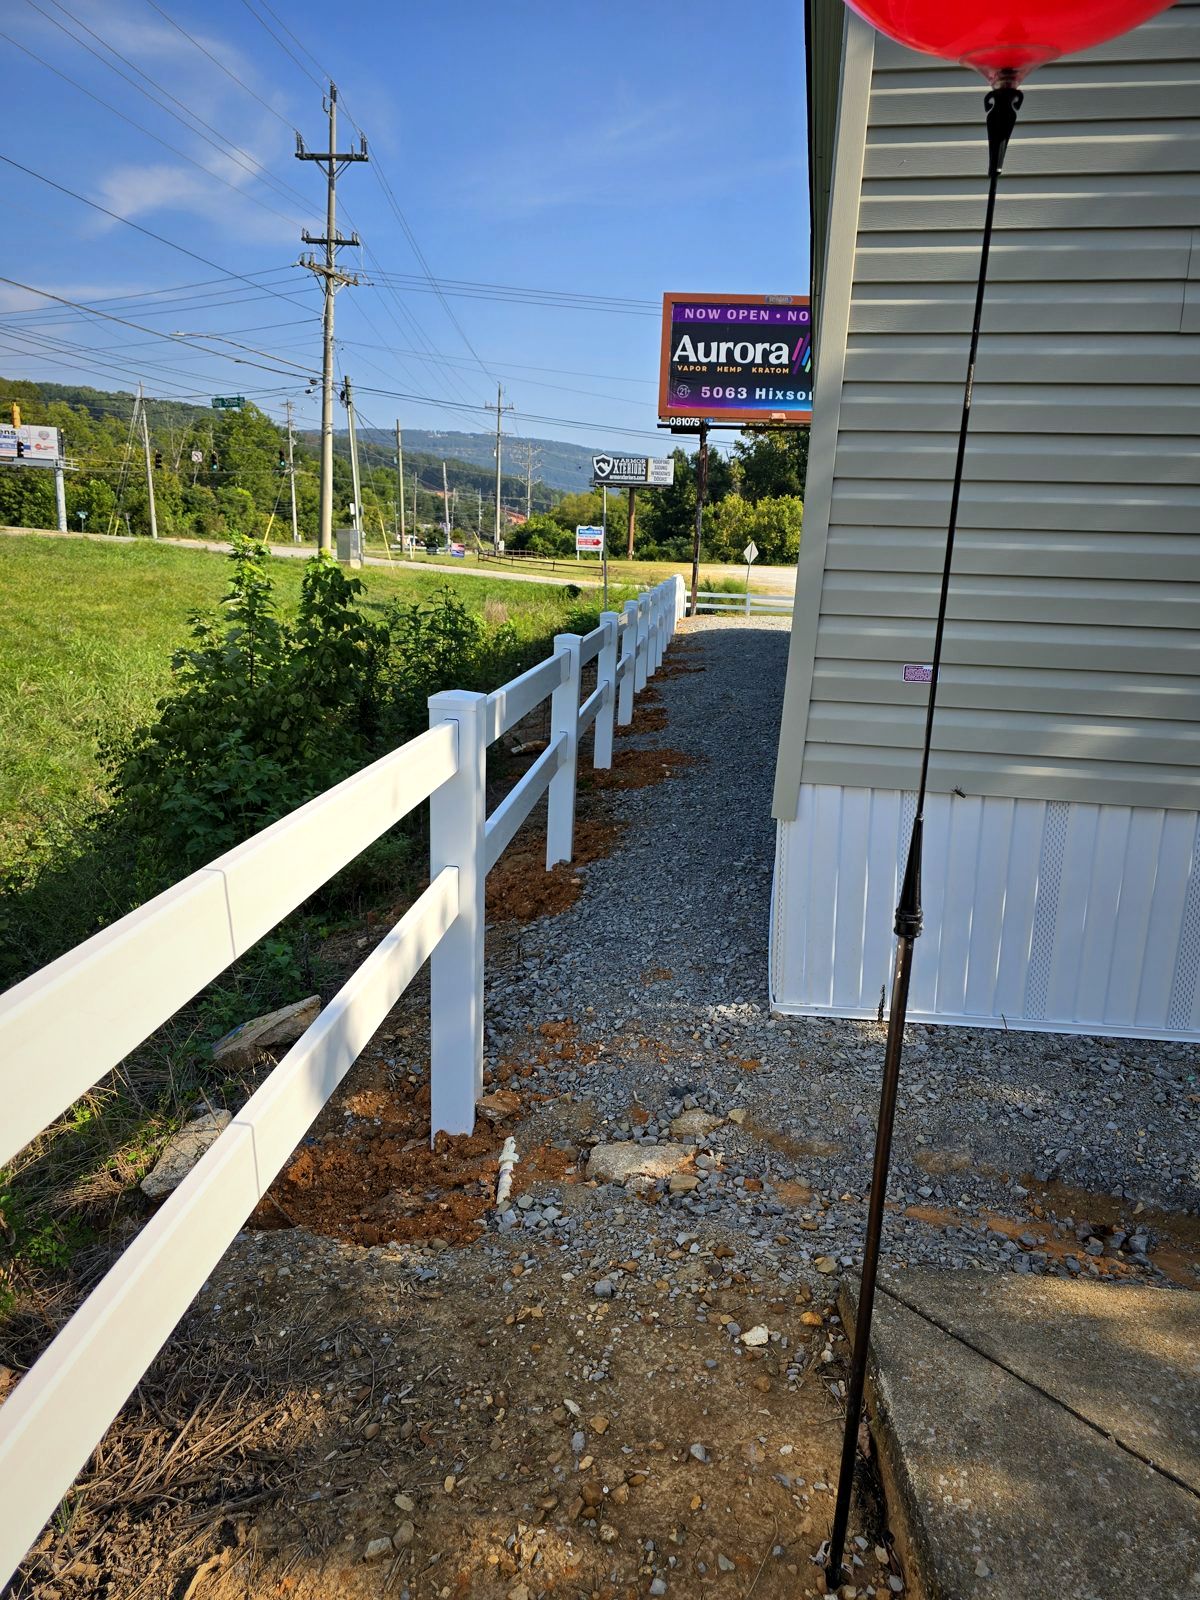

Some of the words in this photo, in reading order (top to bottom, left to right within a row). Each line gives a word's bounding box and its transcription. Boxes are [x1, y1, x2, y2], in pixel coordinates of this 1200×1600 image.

[684, 308, 721, 319] NOW
[726, 309, 769, 320] OPEN
[672, 334, 789, 364] Aurora
[701, 386, 747, 399] 5063
[670, 416, 700, 426] 081075
